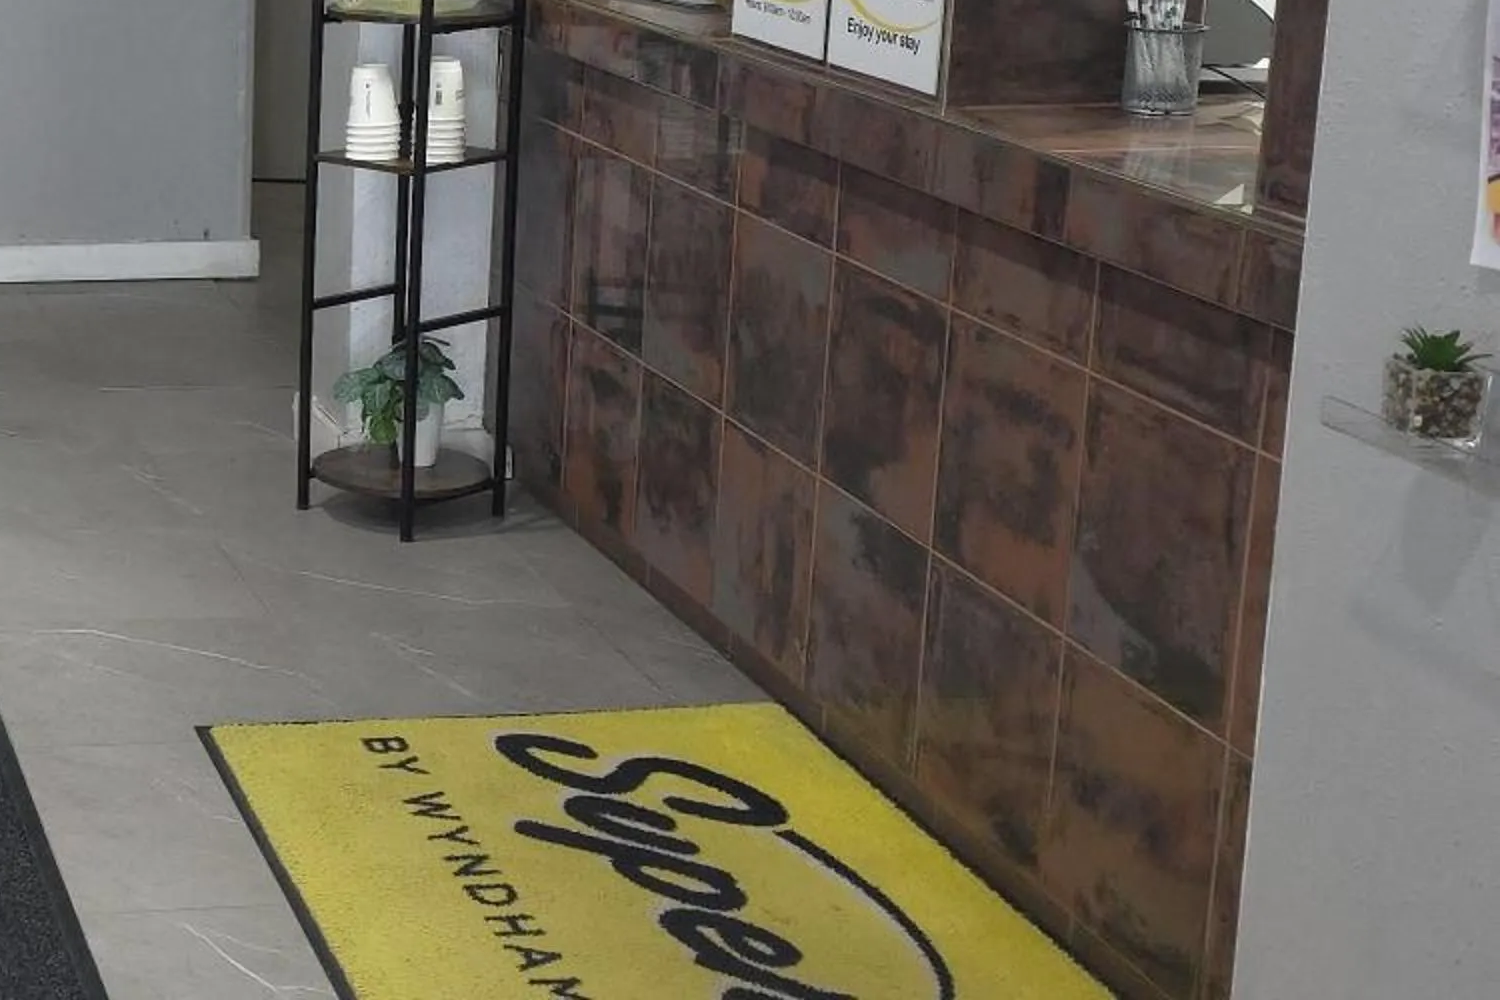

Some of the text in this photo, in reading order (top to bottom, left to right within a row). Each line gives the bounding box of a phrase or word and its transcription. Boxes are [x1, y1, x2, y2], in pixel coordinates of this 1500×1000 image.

[847, 17, 921, 55] Enjoy your stay
[360, 735, 430, 775] BY
